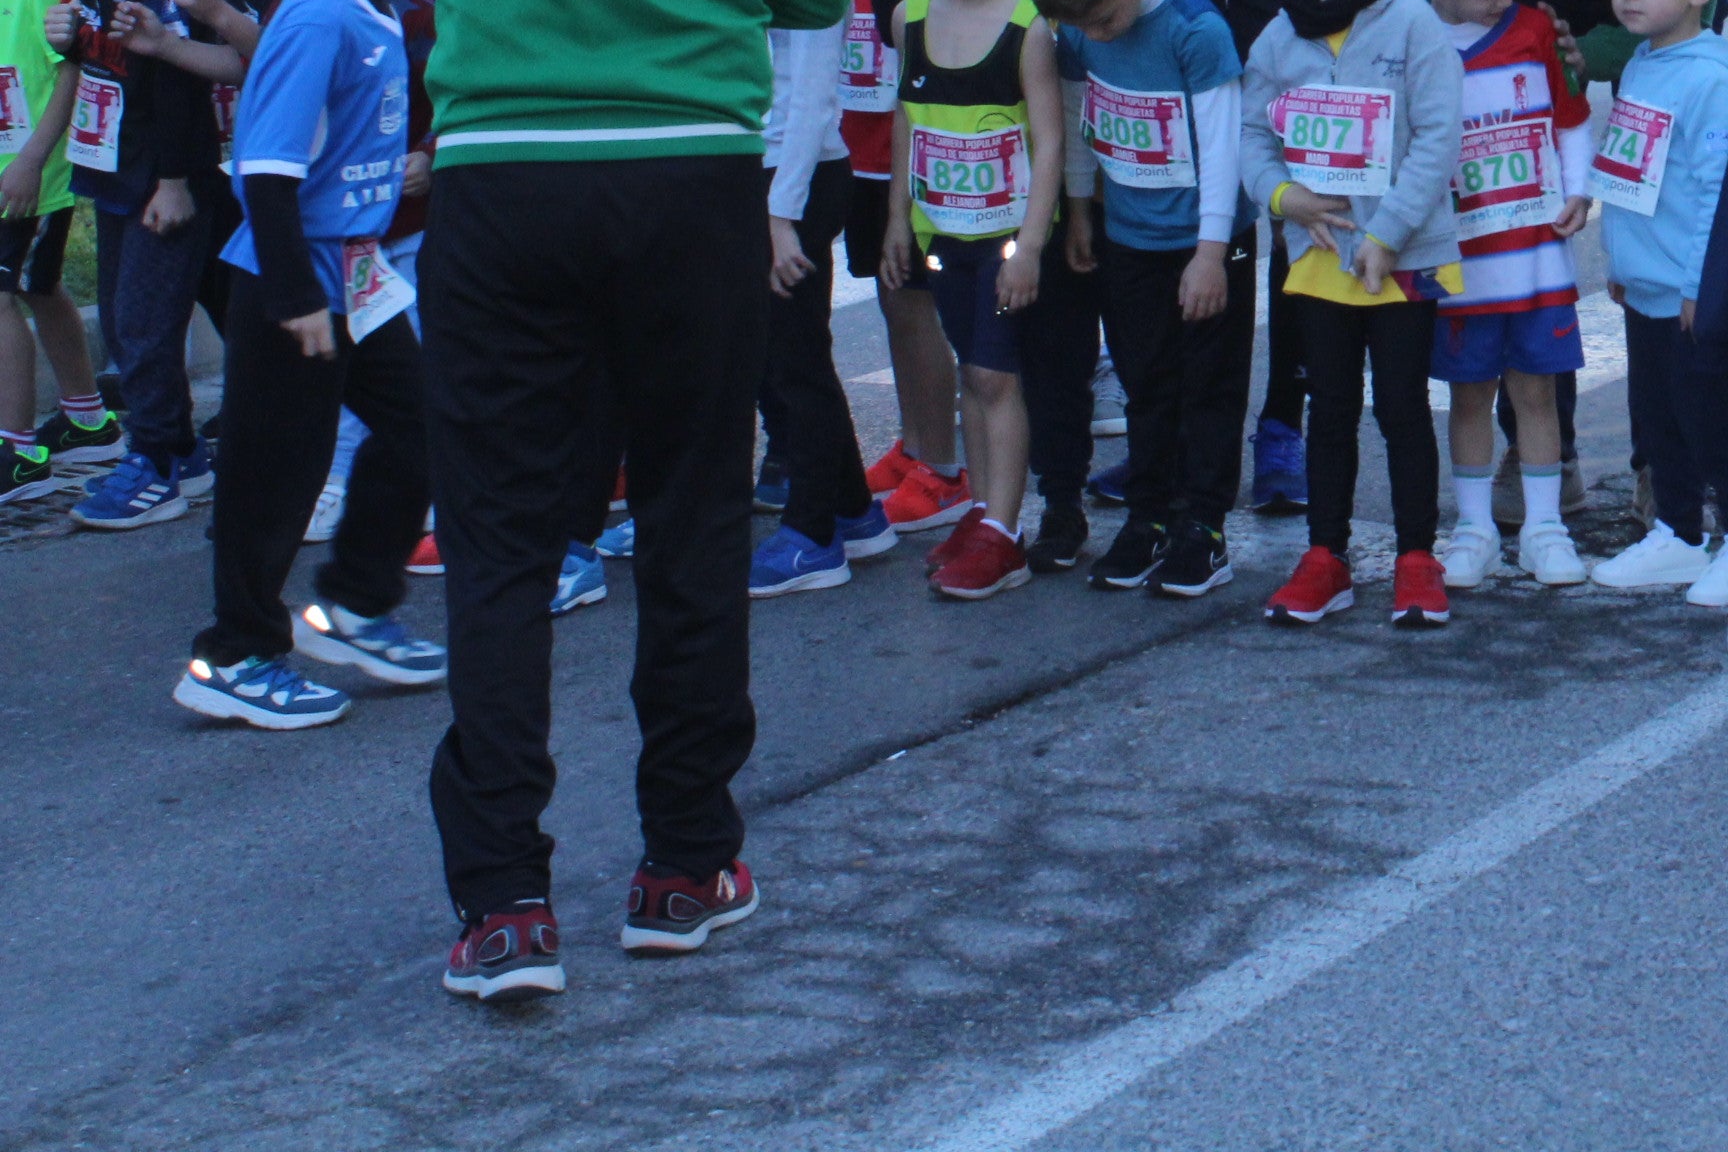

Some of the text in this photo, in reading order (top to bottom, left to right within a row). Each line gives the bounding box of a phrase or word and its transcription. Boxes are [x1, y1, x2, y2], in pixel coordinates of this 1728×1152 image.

[1328, 91, 1366, 105] POPULAR
[965, 135, 1002, 149] POPULAR
[1101, 110, 1152, 149] 808
[1291, 114, 1354, 151] 807
[1462, 132, 1495, 148] ARRERA
[1600, 126, 1638, 163] 74
[1305, 151, 1330, 166] MARIO
[1461, 151, 1529, 193] 870
[934, 160, 995, 193] 820
